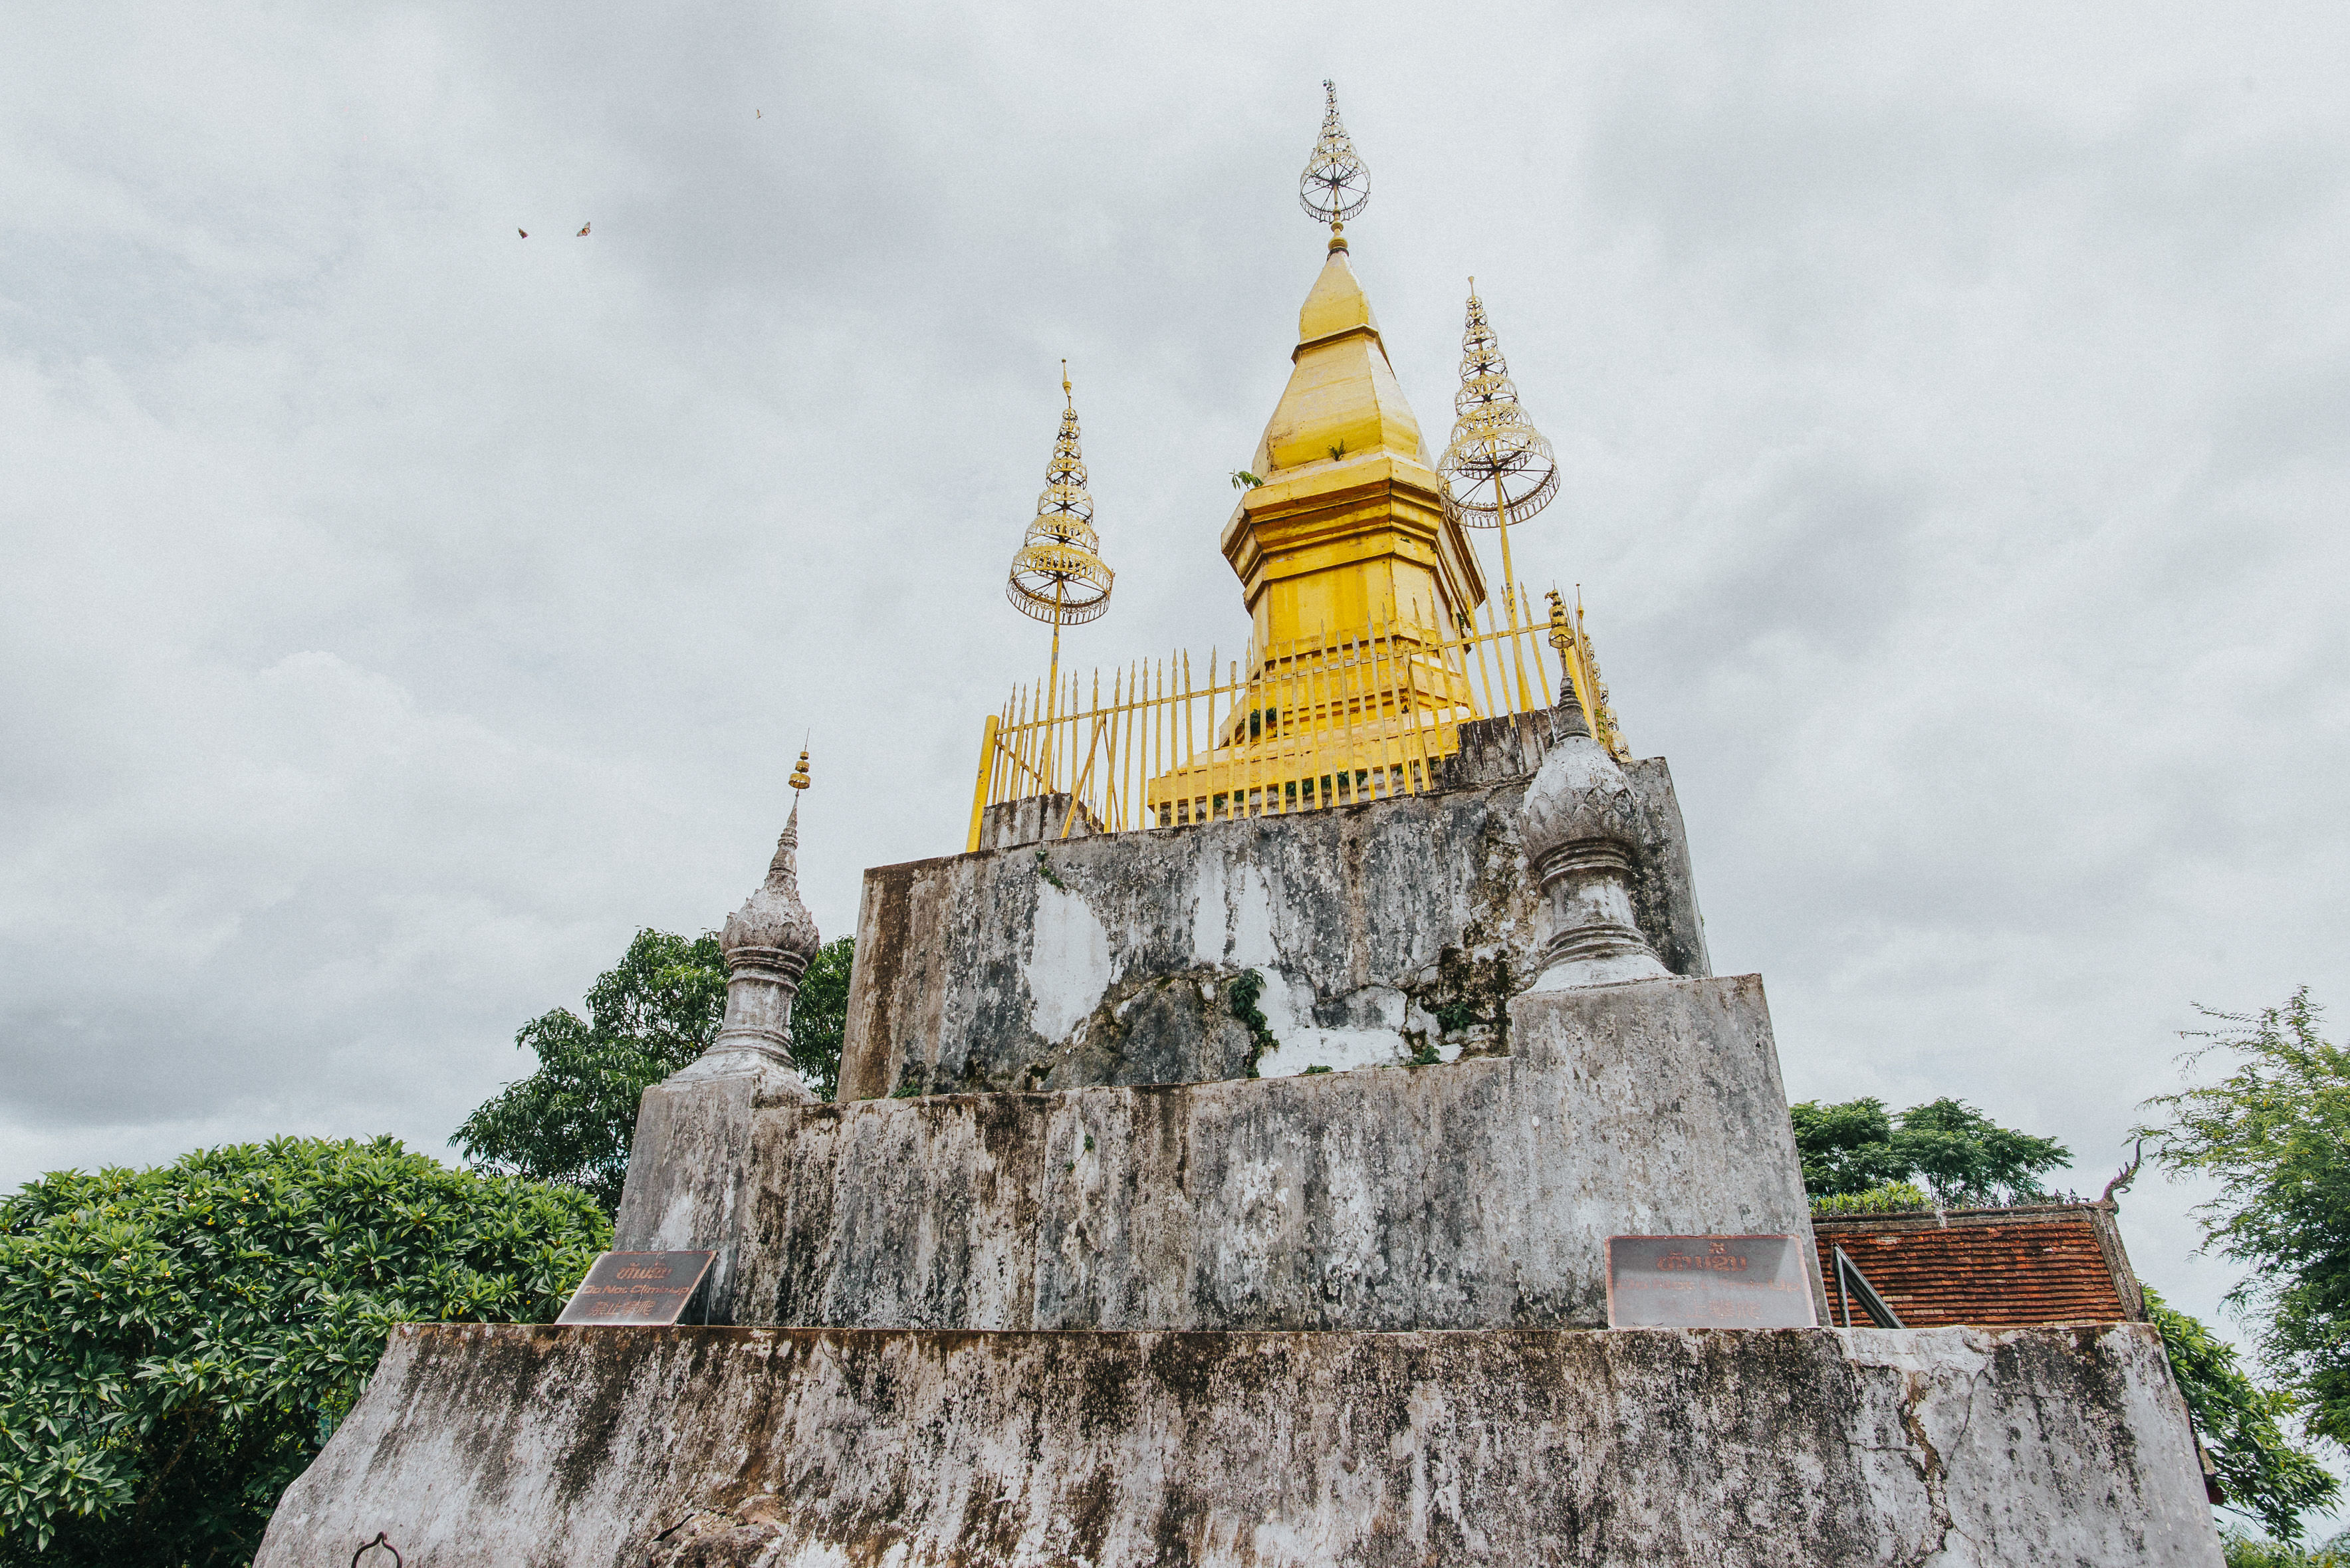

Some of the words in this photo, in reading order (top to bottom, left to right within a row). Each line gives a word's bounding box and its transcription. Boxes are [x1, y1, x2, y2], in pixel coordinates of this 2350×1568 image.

[582, 1285, 602, 1294] Do
[602, 1285, 628, 1294] Not
[1617, 1279, 1649, 1290] Do
[1652, 1279, 1696, 1290] Not
